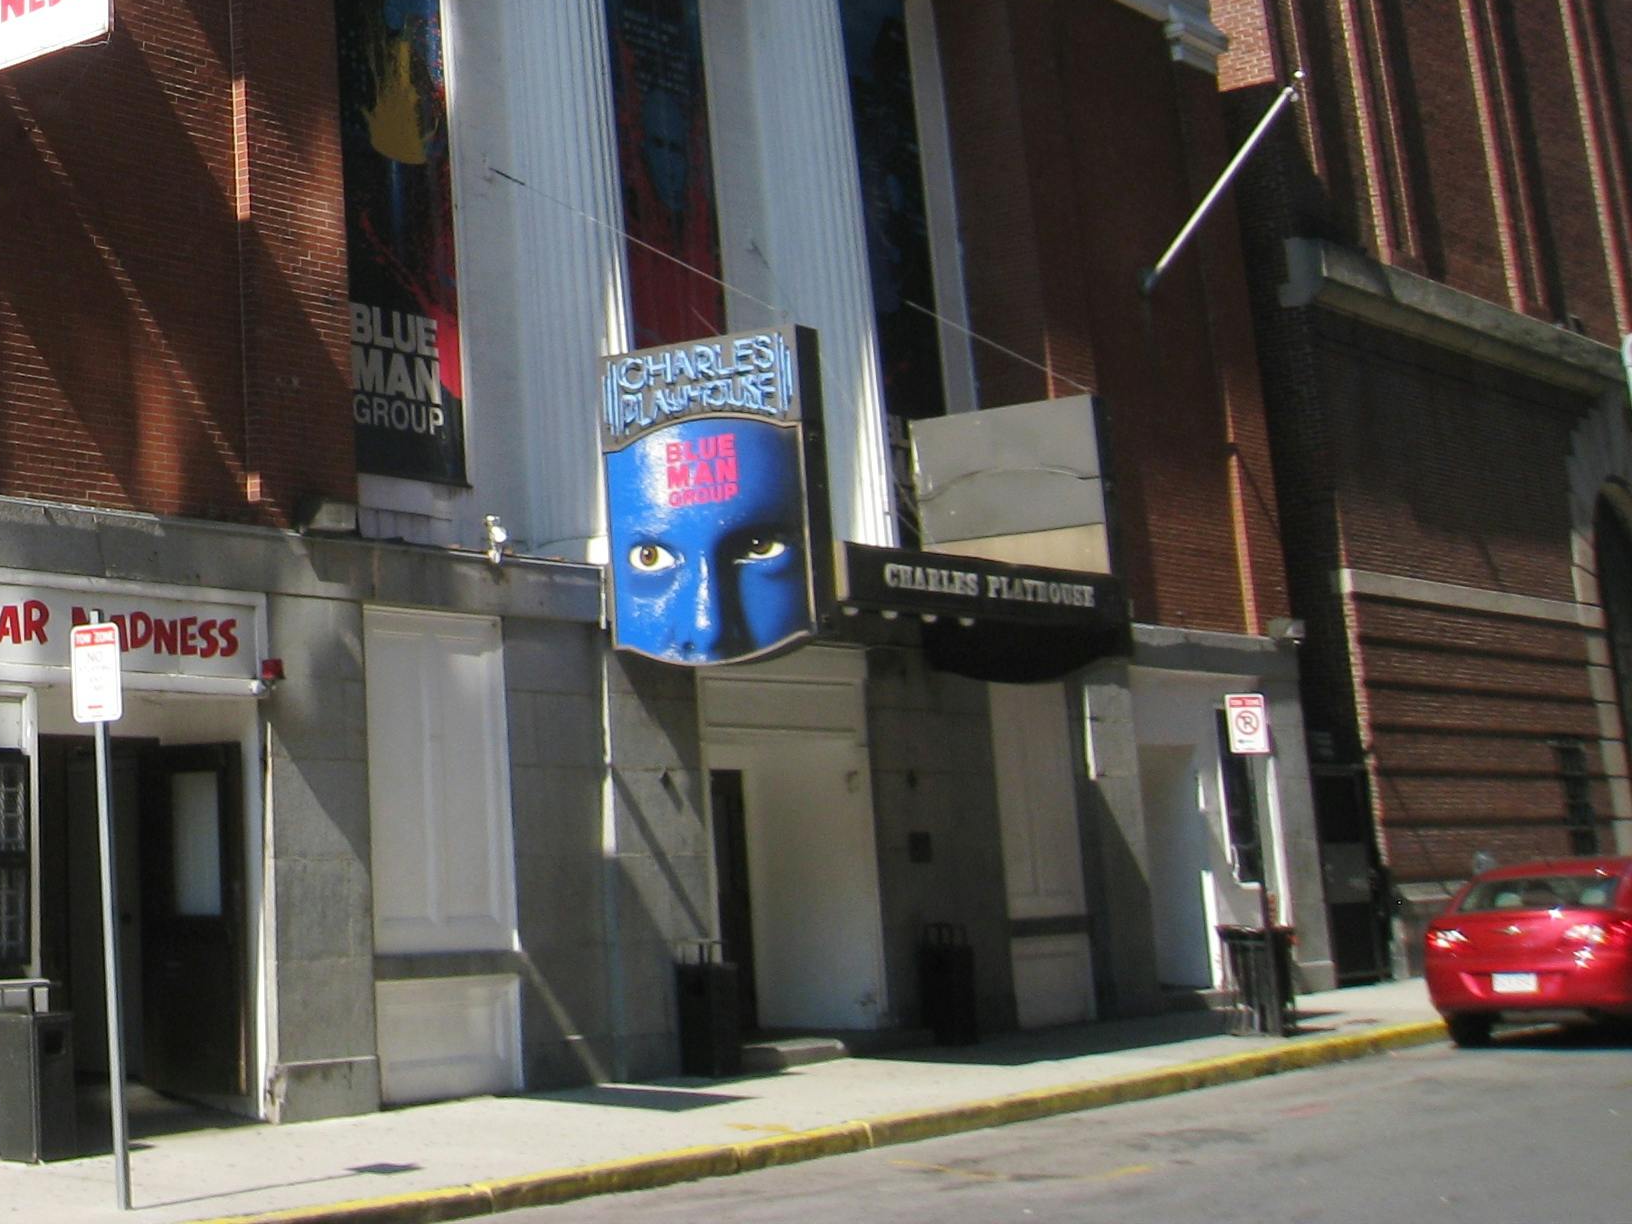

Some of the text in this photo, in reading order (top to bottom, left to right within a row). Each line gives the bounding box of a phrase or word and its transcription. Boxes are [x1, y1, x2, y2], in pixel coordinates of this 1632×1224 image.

[349, 301, 439, 358] BLUE
[351, 344, 443, 406] MAN
[618, 335, 776, 392] CHARLES
[353, 393, 445, 436] GROUP
[621, 372, 779, 431] PLAYHOUSE
[665, 432, 737, 463] BLUE
[666, 457, 739, 490] MAN
[668, 483, 740, 508] GROUP
[884, 563, 1096, 608] CHARLES PLAYHOUSE
